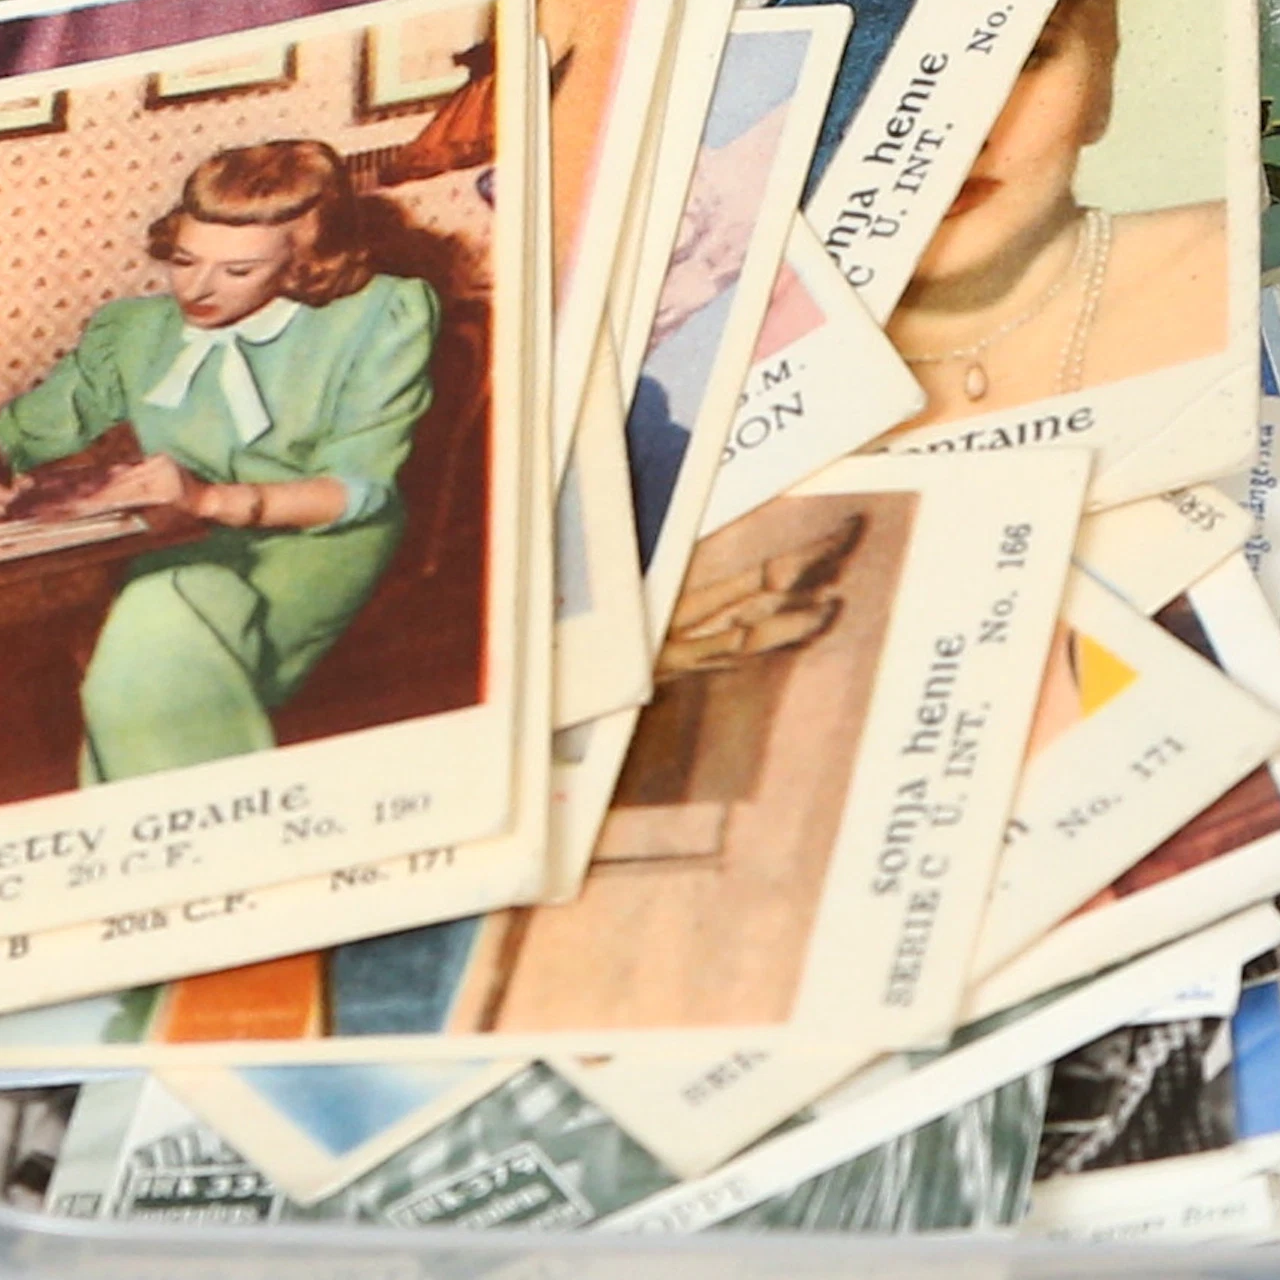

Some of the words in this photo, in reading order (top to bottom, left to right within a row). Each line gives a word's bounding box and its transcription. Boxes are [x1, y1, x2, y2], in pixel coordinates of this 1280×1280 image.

[965, 4, 1014, 56] No.
[996, 523, 1034, 571] 166
[978, 589, 1019, 644] No.
[1055, 794, 1123, 839] No.
[1130, 735, 1187, 780] 171
[281, 813, 347, 846] No.
[919, 853, 951, 880] C
[7, 931, 31, 961] B
[329, 865, 390, 893] No.
[407, 842, 456, 876] 171
